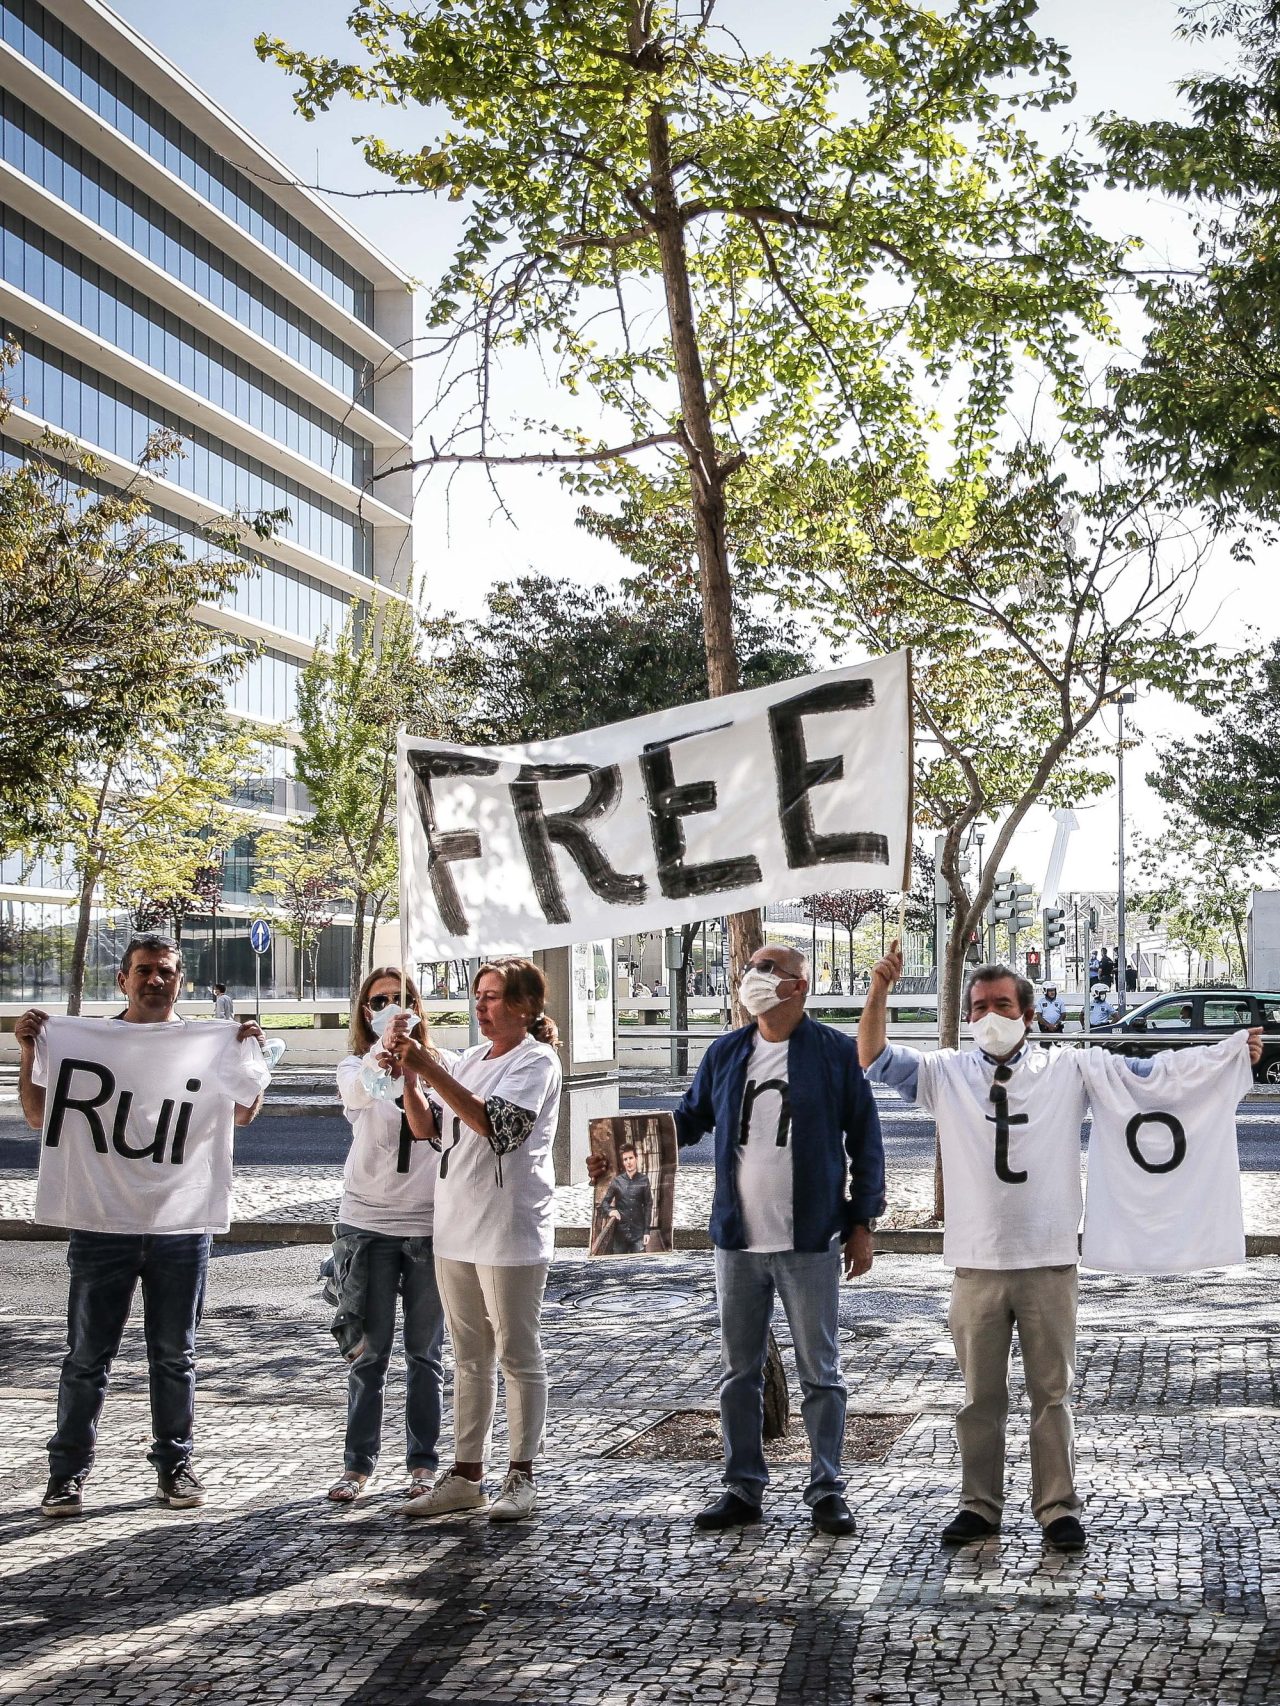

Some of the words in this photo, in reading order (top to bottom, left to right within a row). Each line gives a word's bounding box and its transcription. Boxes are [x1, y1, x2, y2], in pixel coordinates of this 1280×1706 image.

[406, 678, 891, 936] FREE
[45, 1057, 202, 1166] Rui
[738, 1077, 792, 1148] n
